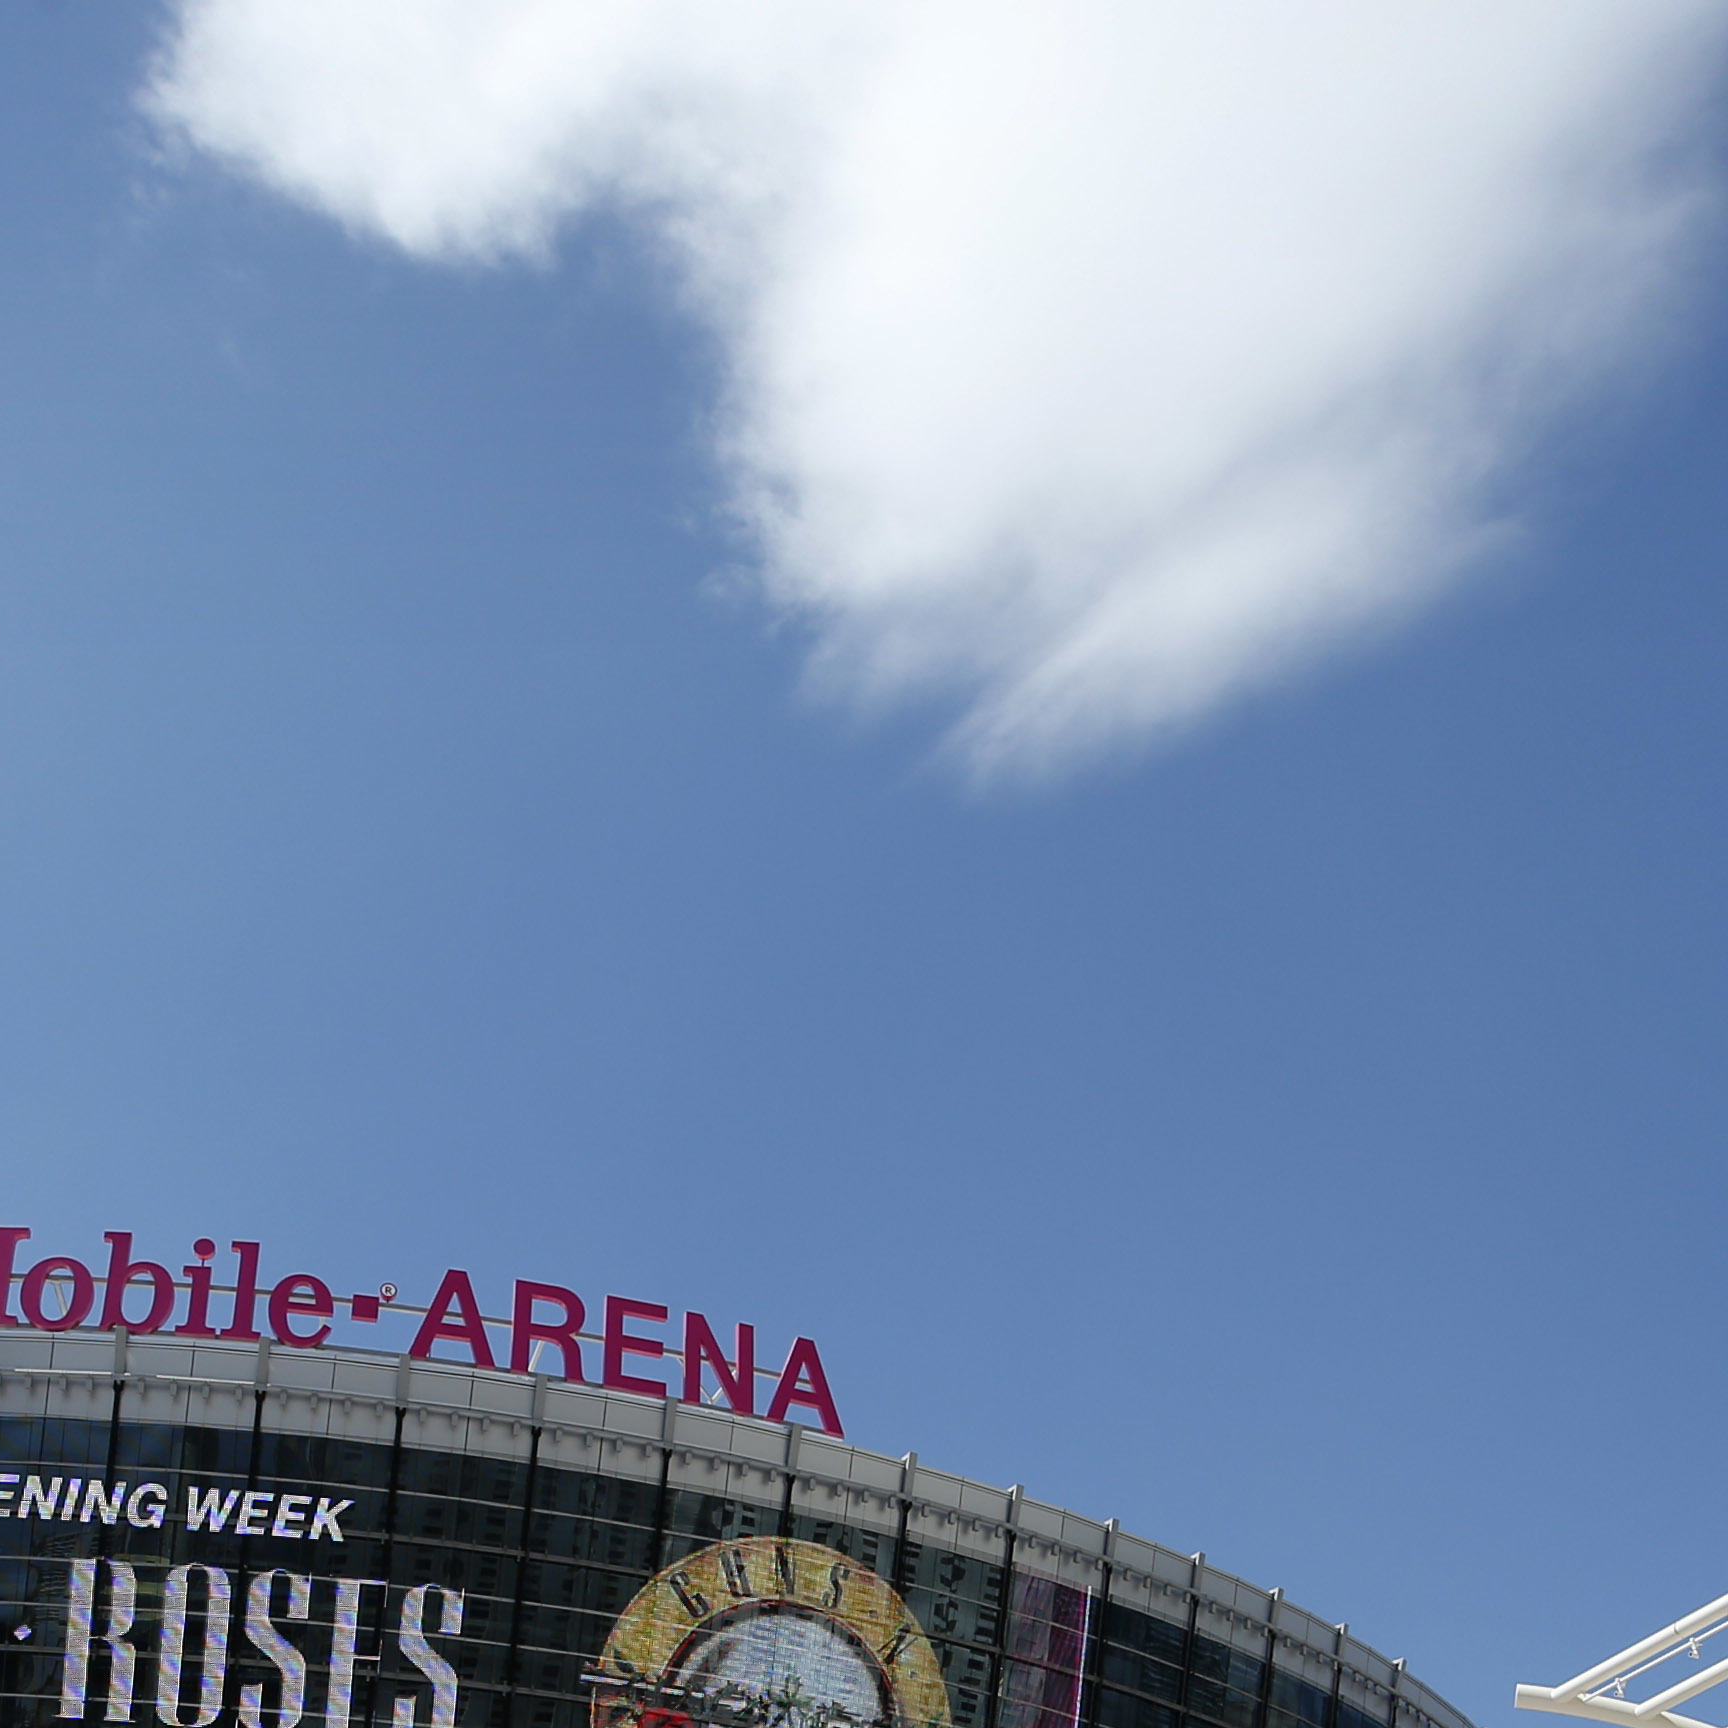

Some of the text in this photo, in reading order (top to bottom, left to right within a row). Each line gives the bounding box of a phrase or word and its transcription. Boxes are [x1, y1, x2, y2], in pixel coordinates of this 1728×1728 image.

[409, 1268, 844, 1438] ARENA
[185, 1485, 355, 1543] WEEK
[669, 1546, 851, 1619] GUNS
